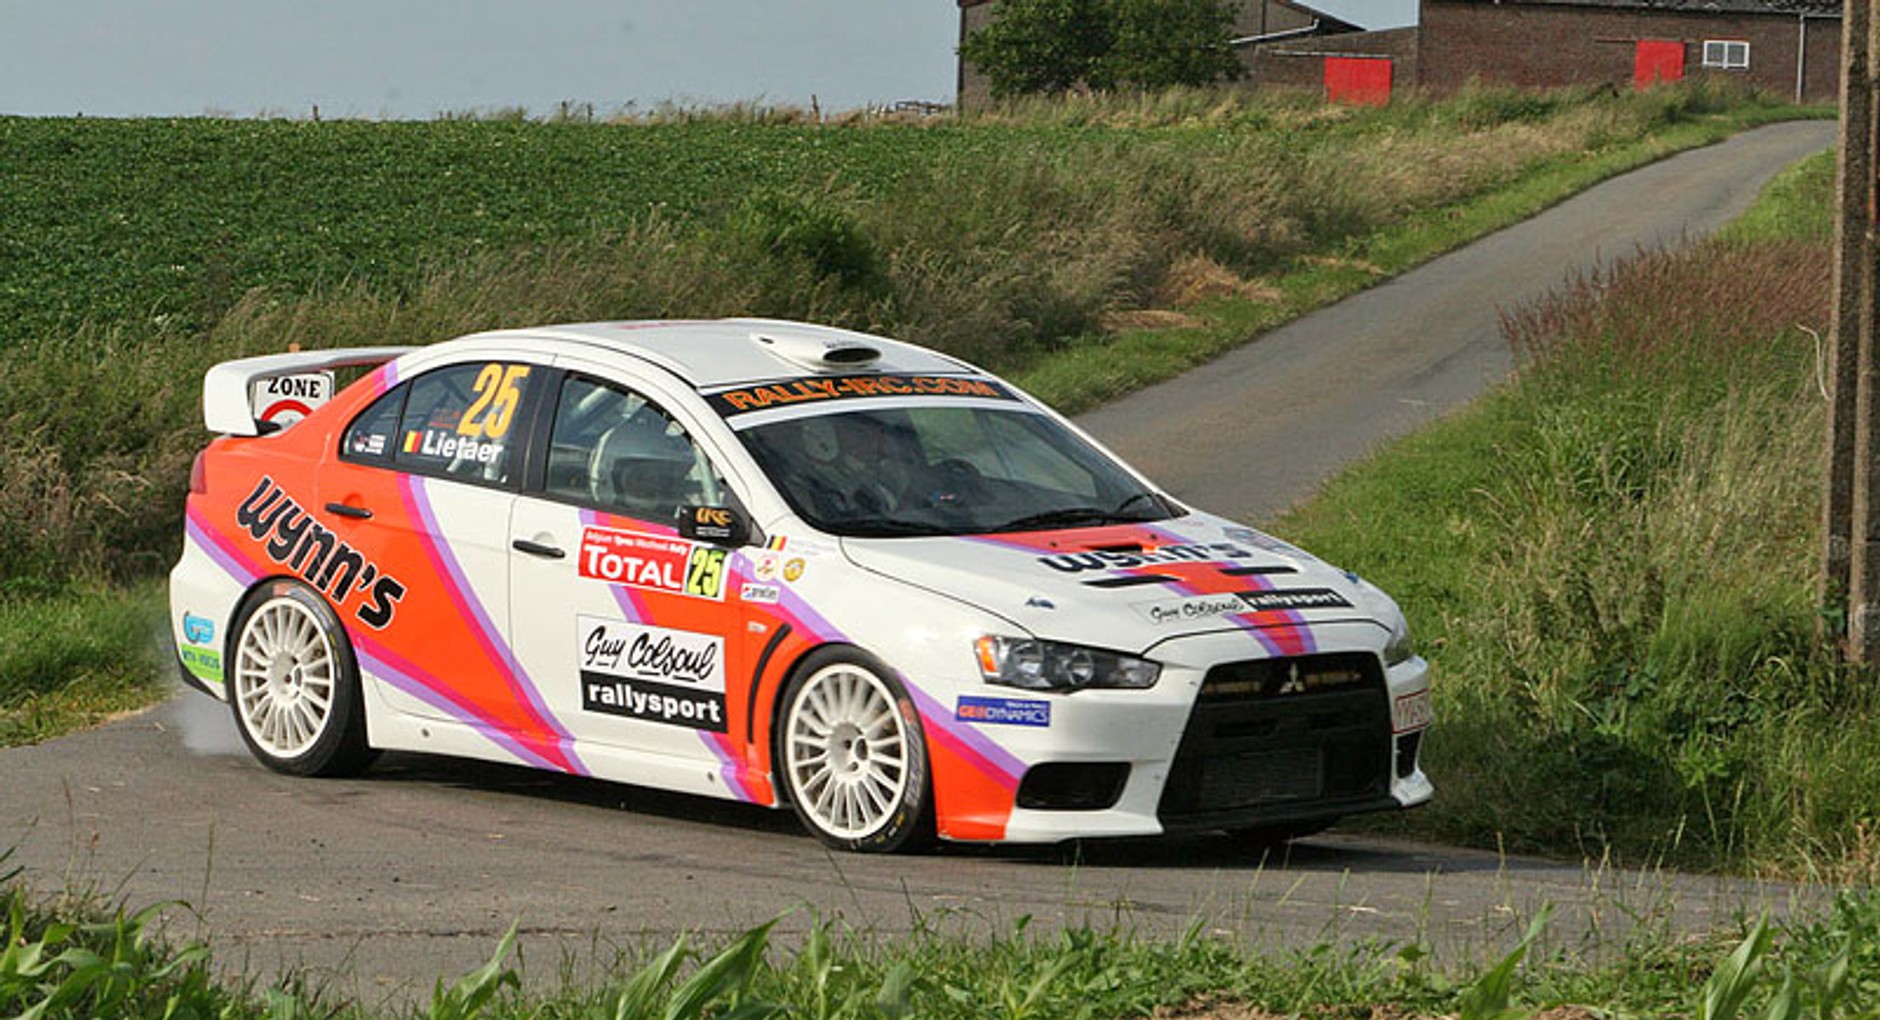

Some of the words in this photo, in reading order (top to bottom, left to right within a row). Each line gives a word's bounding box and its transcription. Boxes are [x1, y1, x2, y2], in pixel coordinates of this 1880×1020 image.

[267, 376, 321, 398] ZONE
[457, 363, 532, 438] 25
[721, 376, 999, 410] RALLY-IRC.COM
[421, 430, 504, 463] Lietaer
[584, 544, 680, 588] TOTAL
[687, 548, 725, 597] 25
[1246, 591, 1343, 607] rallysport
[585, 625, 626, 669] Guy
[628, 631, 717, 683] Colsoul
[588, 683, 721, 723] rallysport
